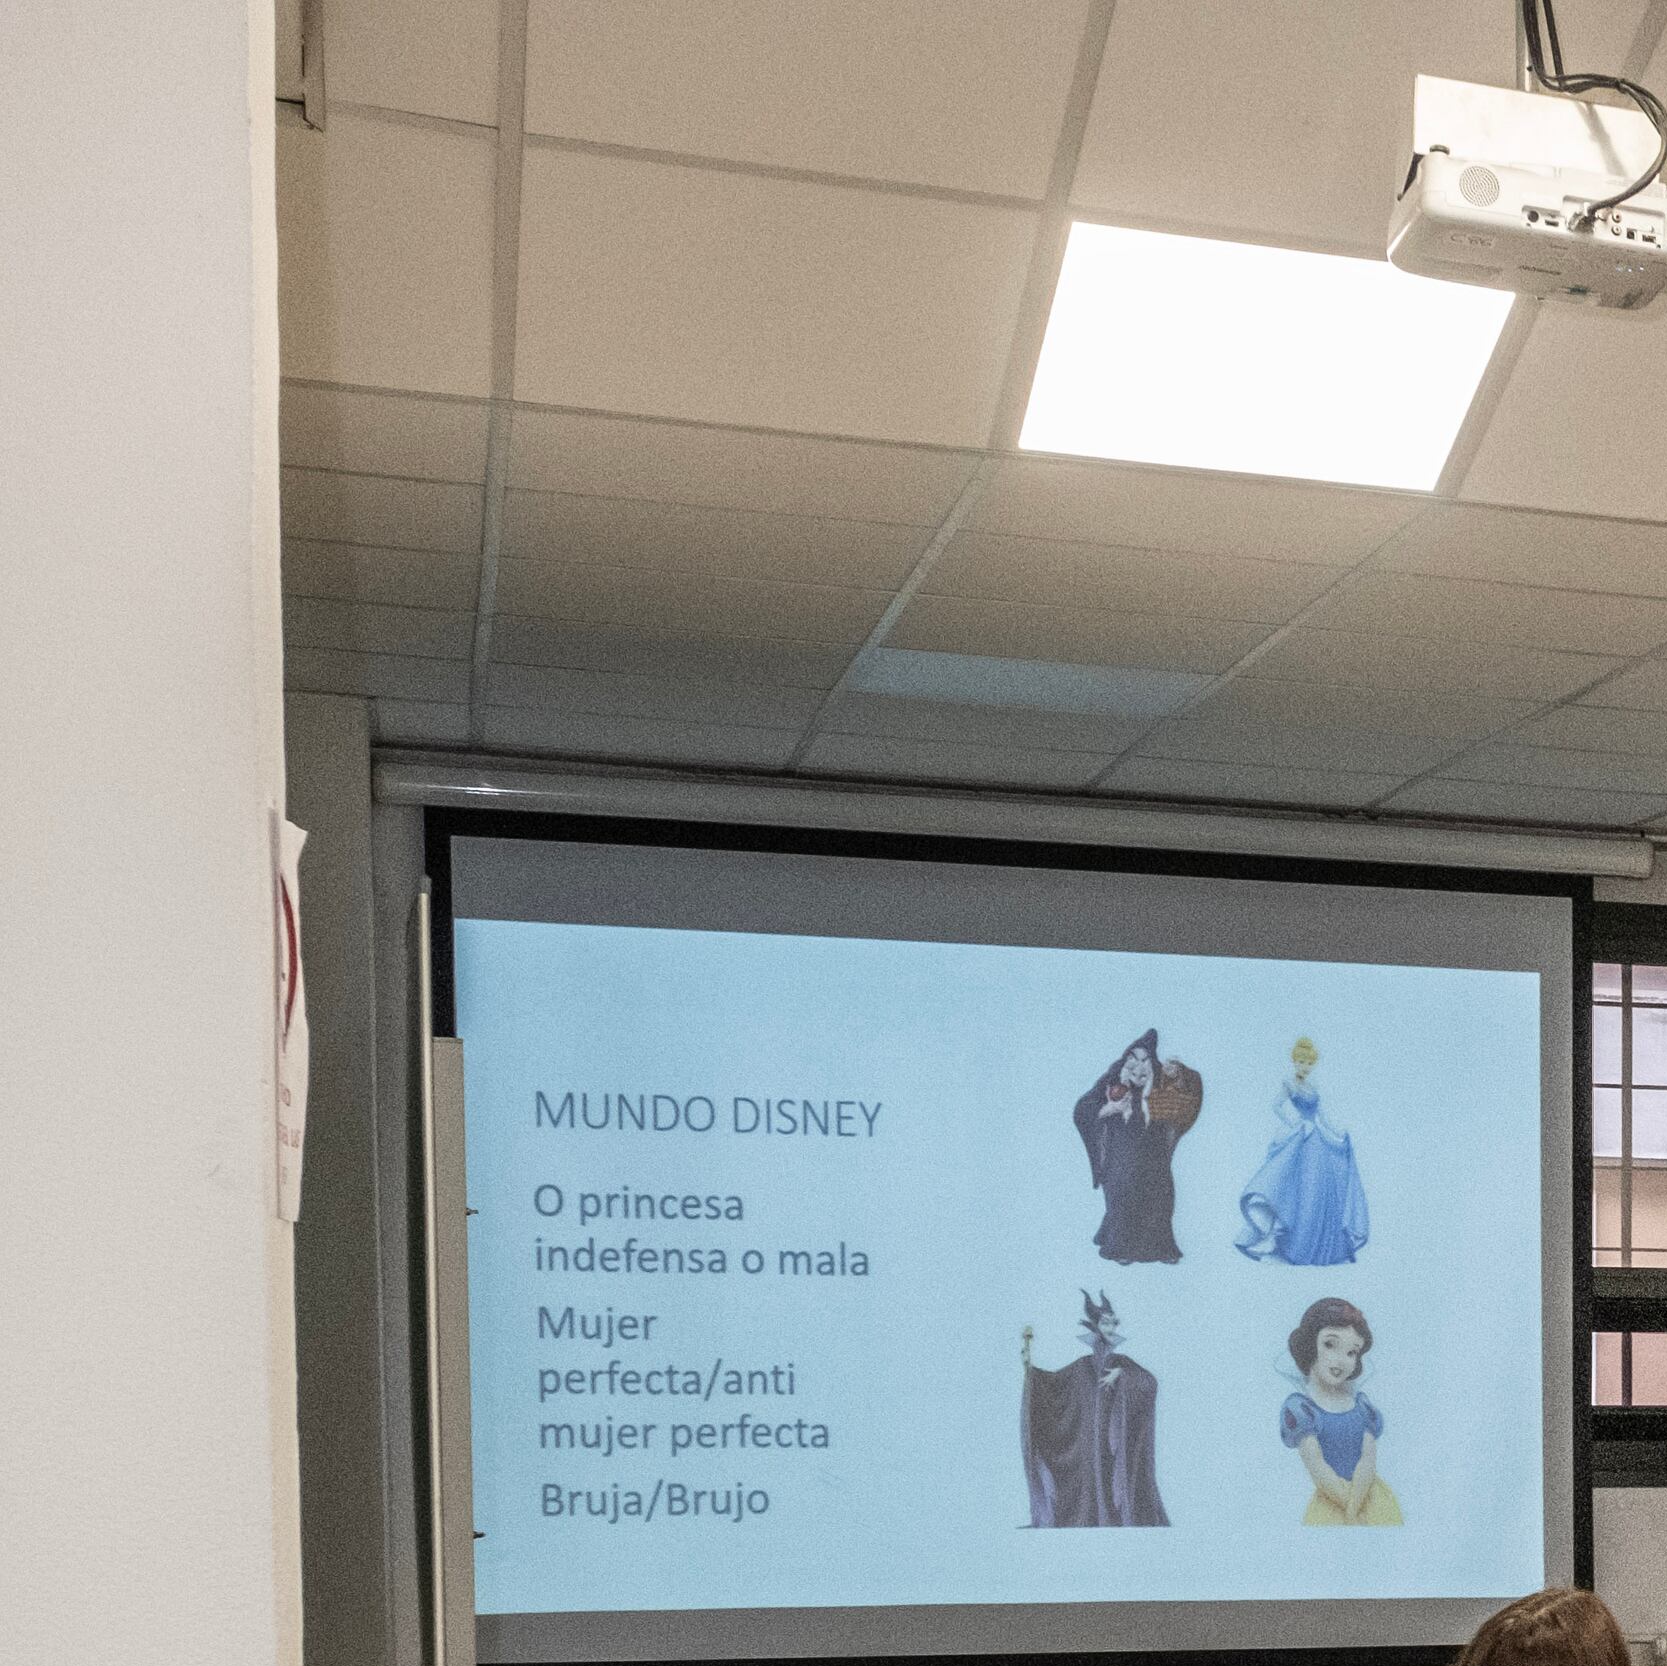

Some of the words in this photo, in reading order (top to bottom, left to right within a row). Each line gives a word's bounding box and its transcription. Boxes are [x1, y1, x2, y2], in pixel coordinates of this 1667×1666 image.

[534, 1090, 716, 1133] MUNDO
[732, 1096, 883, 1138] DISNEY
[533, 1183, 564, 1217] O
[579, 1185, 744, 1227] princesa
[535, 1237, 728, 1275] indefensa
[741, 1249, 765, 1275] o
[778, 1241, 870, 1277] mala
[537, 1305, 658, 1349] Mujer
[538, 1358, 796, 1404] perfecta/anti
[539, 1415, 658, 1457] mujer
[670, 1413, 830, 1457] perfecta
[541, 1479, 771, 1525] Bruja/Brujo
